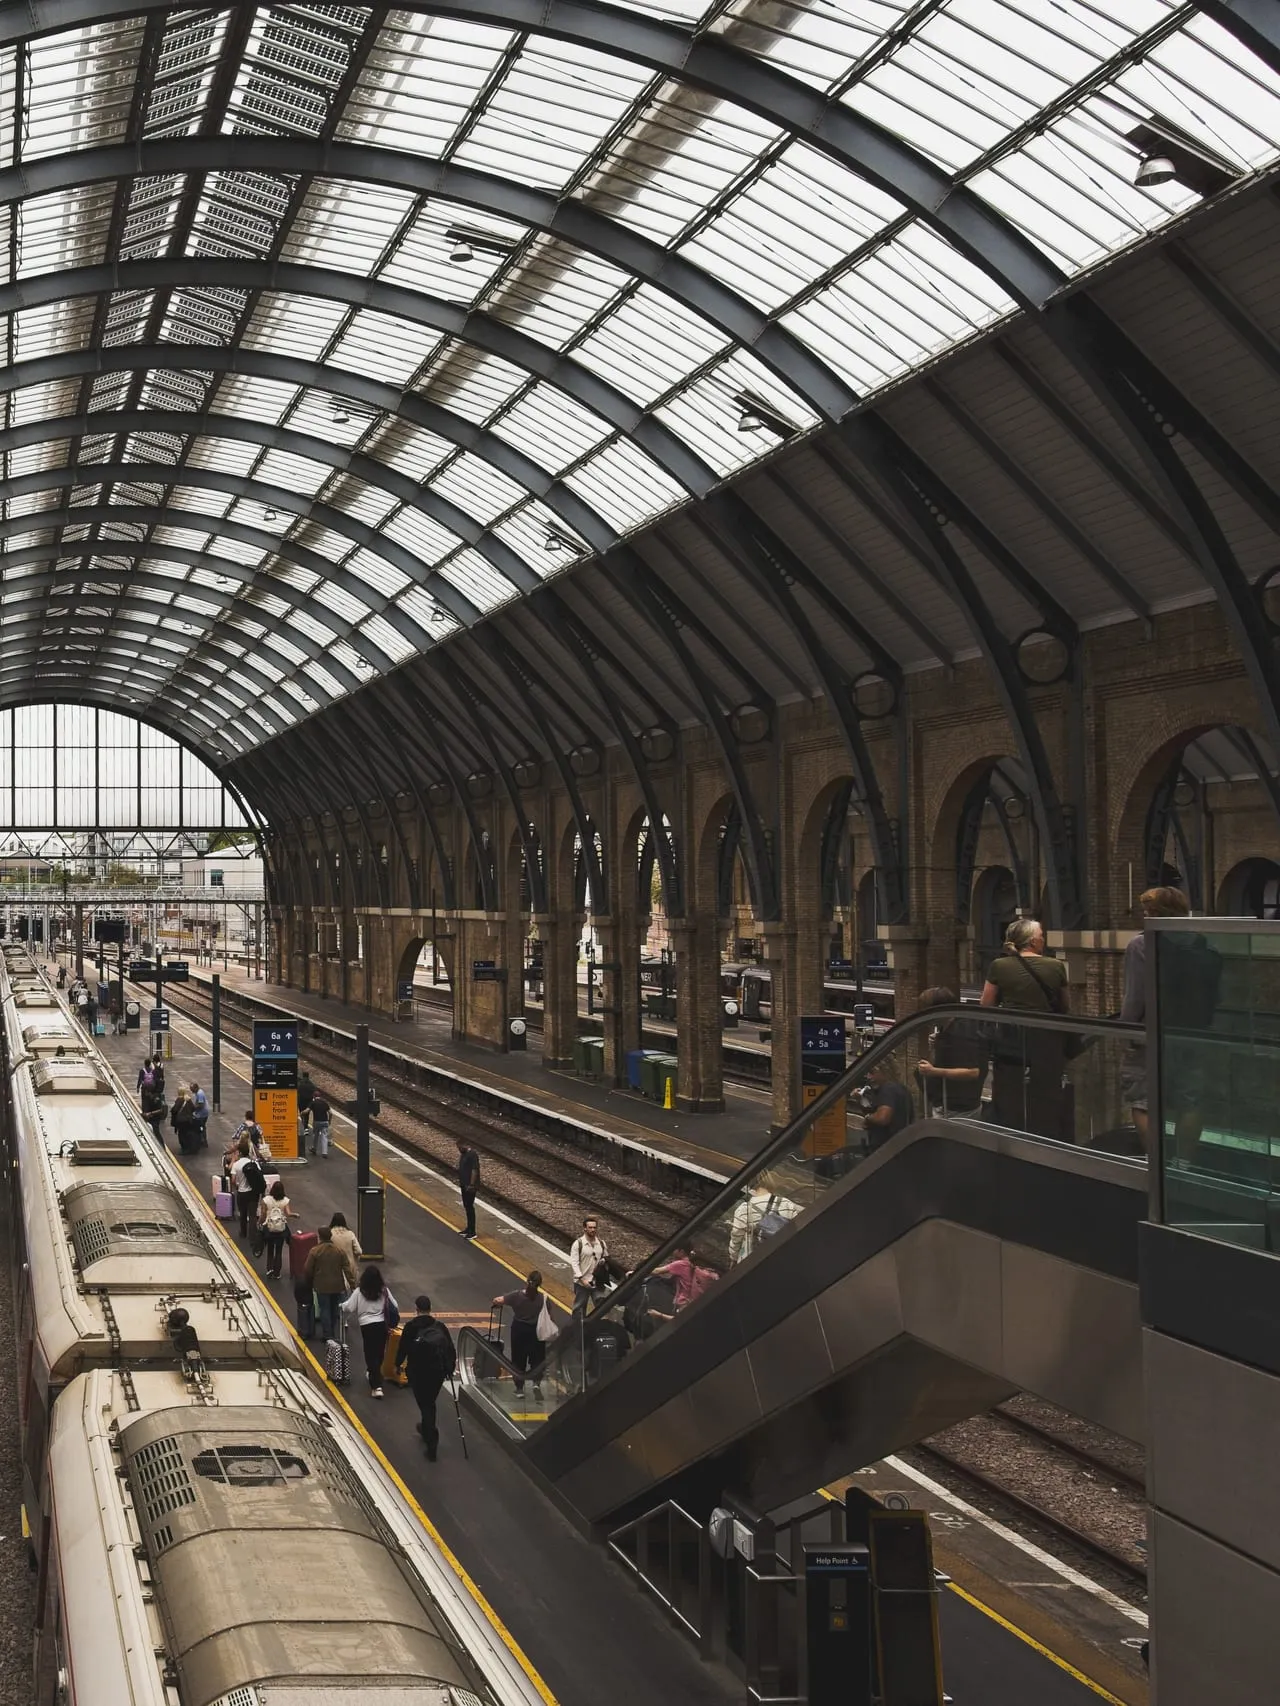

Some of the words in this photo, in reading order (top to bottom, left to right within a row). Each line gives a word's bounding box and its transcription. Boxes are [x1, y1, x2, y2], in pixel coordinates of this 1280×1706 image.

[271, 1032, 281, 1040] 6a
[818, 1028, 828, 1036] 4a
[271, 1044, 281, 1052] 7a
[818, 1040, 829, 1048] 5a
[816, 1557, 831, 1565] Help
[832, 1557, 848, 1565] Point
